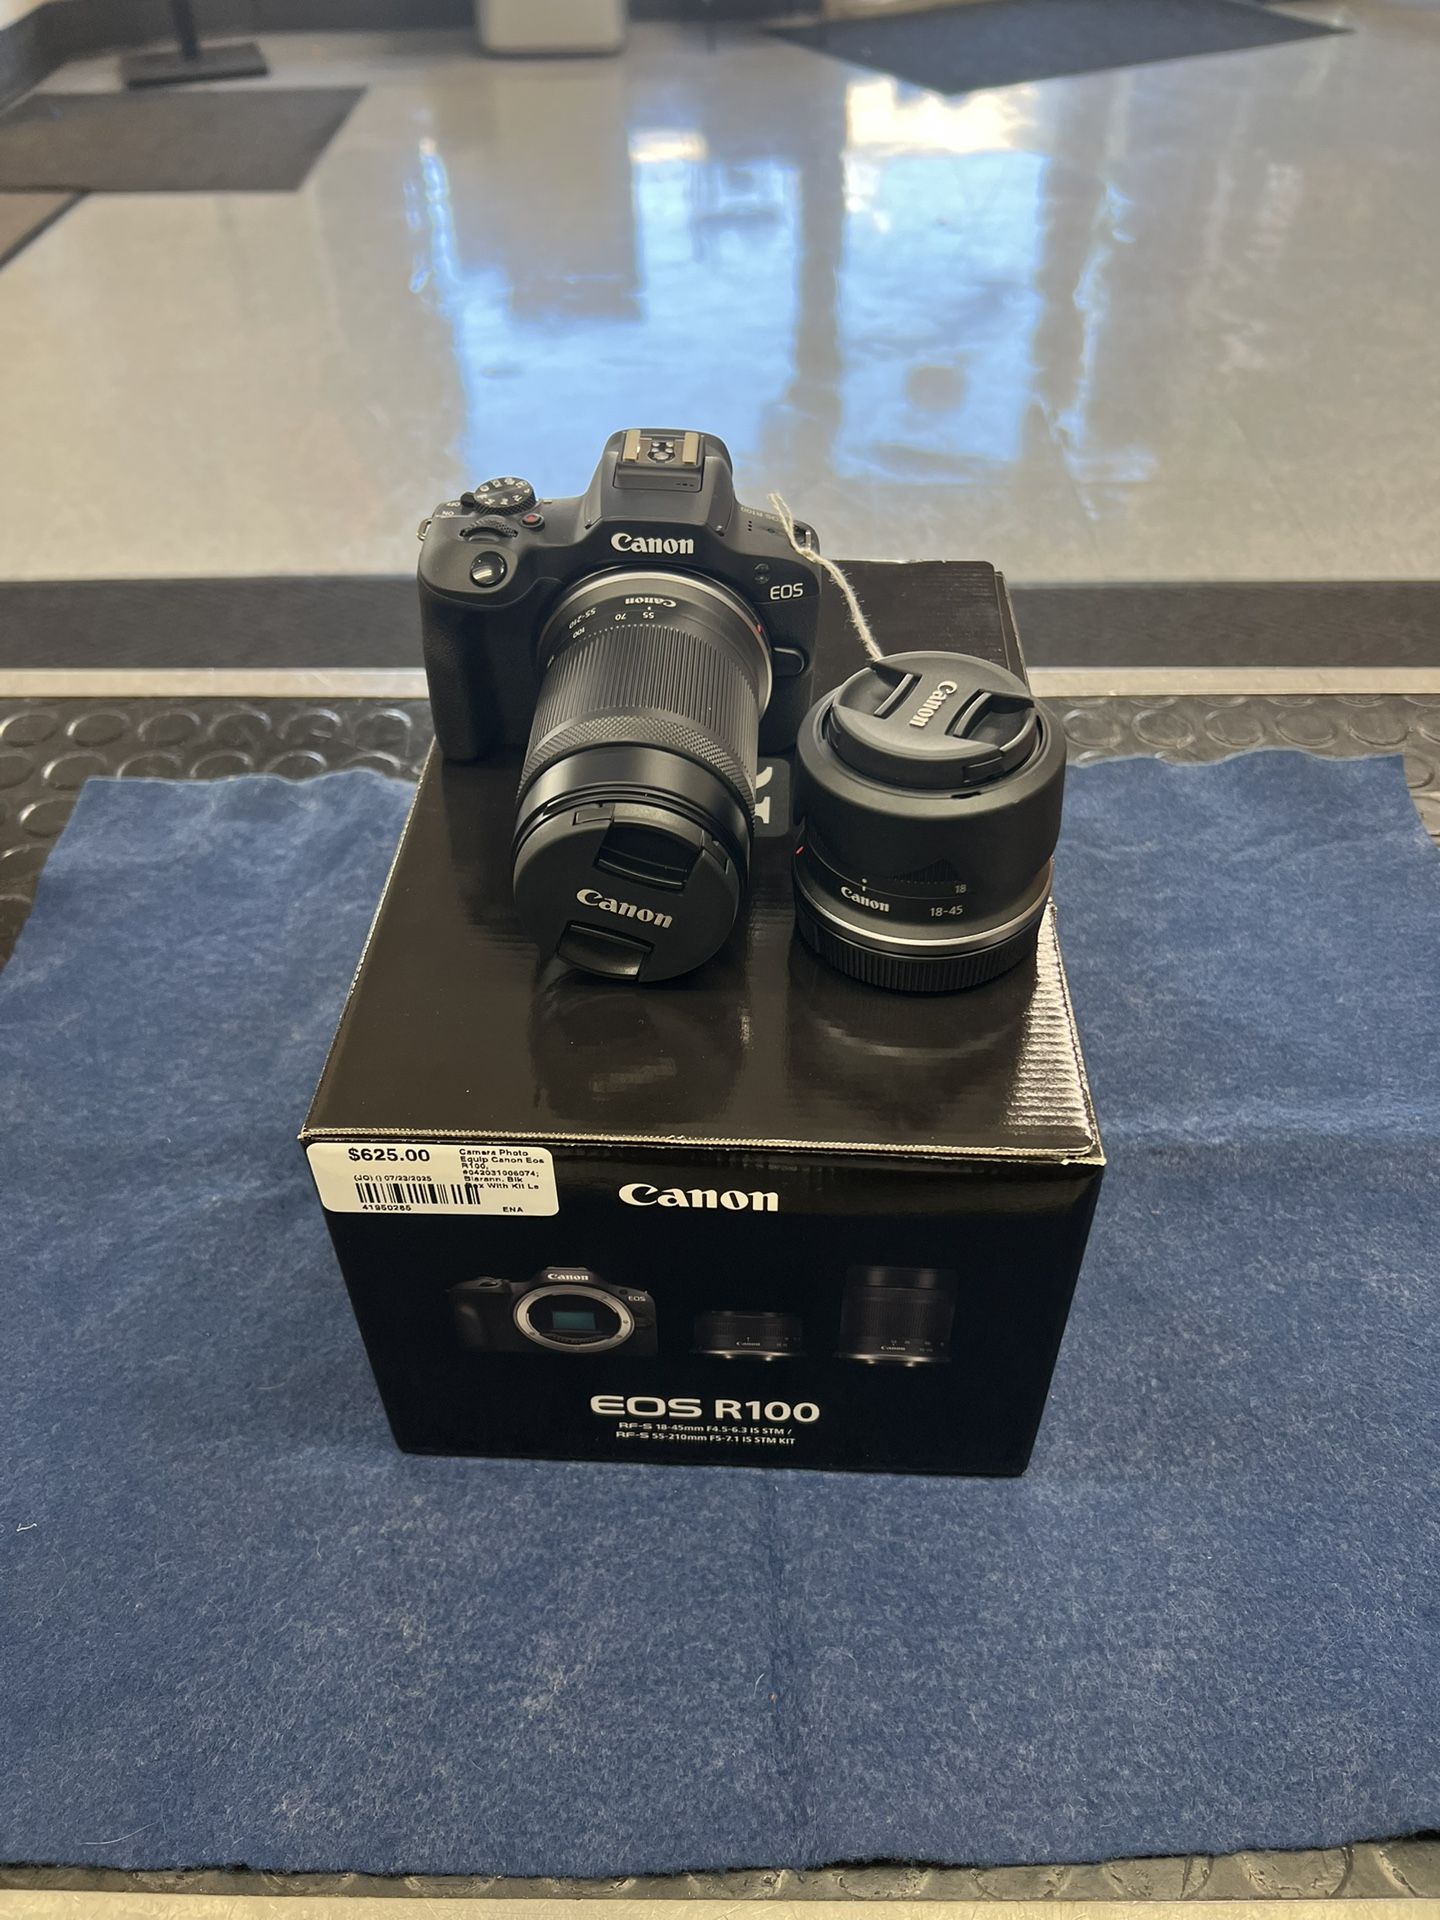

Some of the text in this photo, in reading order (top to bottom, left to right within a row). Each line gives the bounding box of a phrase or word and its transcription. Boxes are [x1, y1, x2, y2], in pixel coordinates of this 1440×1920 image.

[740, 506, 763, 518] R100
[611, 532, 694, 554] Canon
[770, 582, 804, 600] EOS
[625, 597, 677, 608] Canon
[568, 607, 597, 630] 55-210
[572, 611, 655, 639] 100 70 55
[909, 680, 958, 727] Canon
[954, 884, 967, 894] 18
[840, 886, 890, 913] Canon
[576, 888, 673, 929] Canon
[930, 905, 964, 917] 18-45
[348, 1147, 431, 1162] $625.00
[459, 1148, 529, 1157] Camera Photo
[460, 1156, 489, 1164] Equip
[618, 1183, 779, 1212] Canon
[362, 1204, 412, 1212] 41950285
[547, 1272, 589, 1281] Canon
[590, 1395, 821, 1423] EOS R100
[618, 1421, 653, 1430] RF-S
[655, 1423, 704, 1432] 18-45mm
[706, 1425, 748, 1434] F4.5-6.3
[762, 1427, 785, 1435] STM
[615, 1431, 650, 1439] RF-S
[652, 1432, 708, 1441] 55-210mm
[709, 1434, 739, 1443] F5-7.1
[754, 1436, 777, 1444] STM
[778, 1437, 796, 1445] KIT
